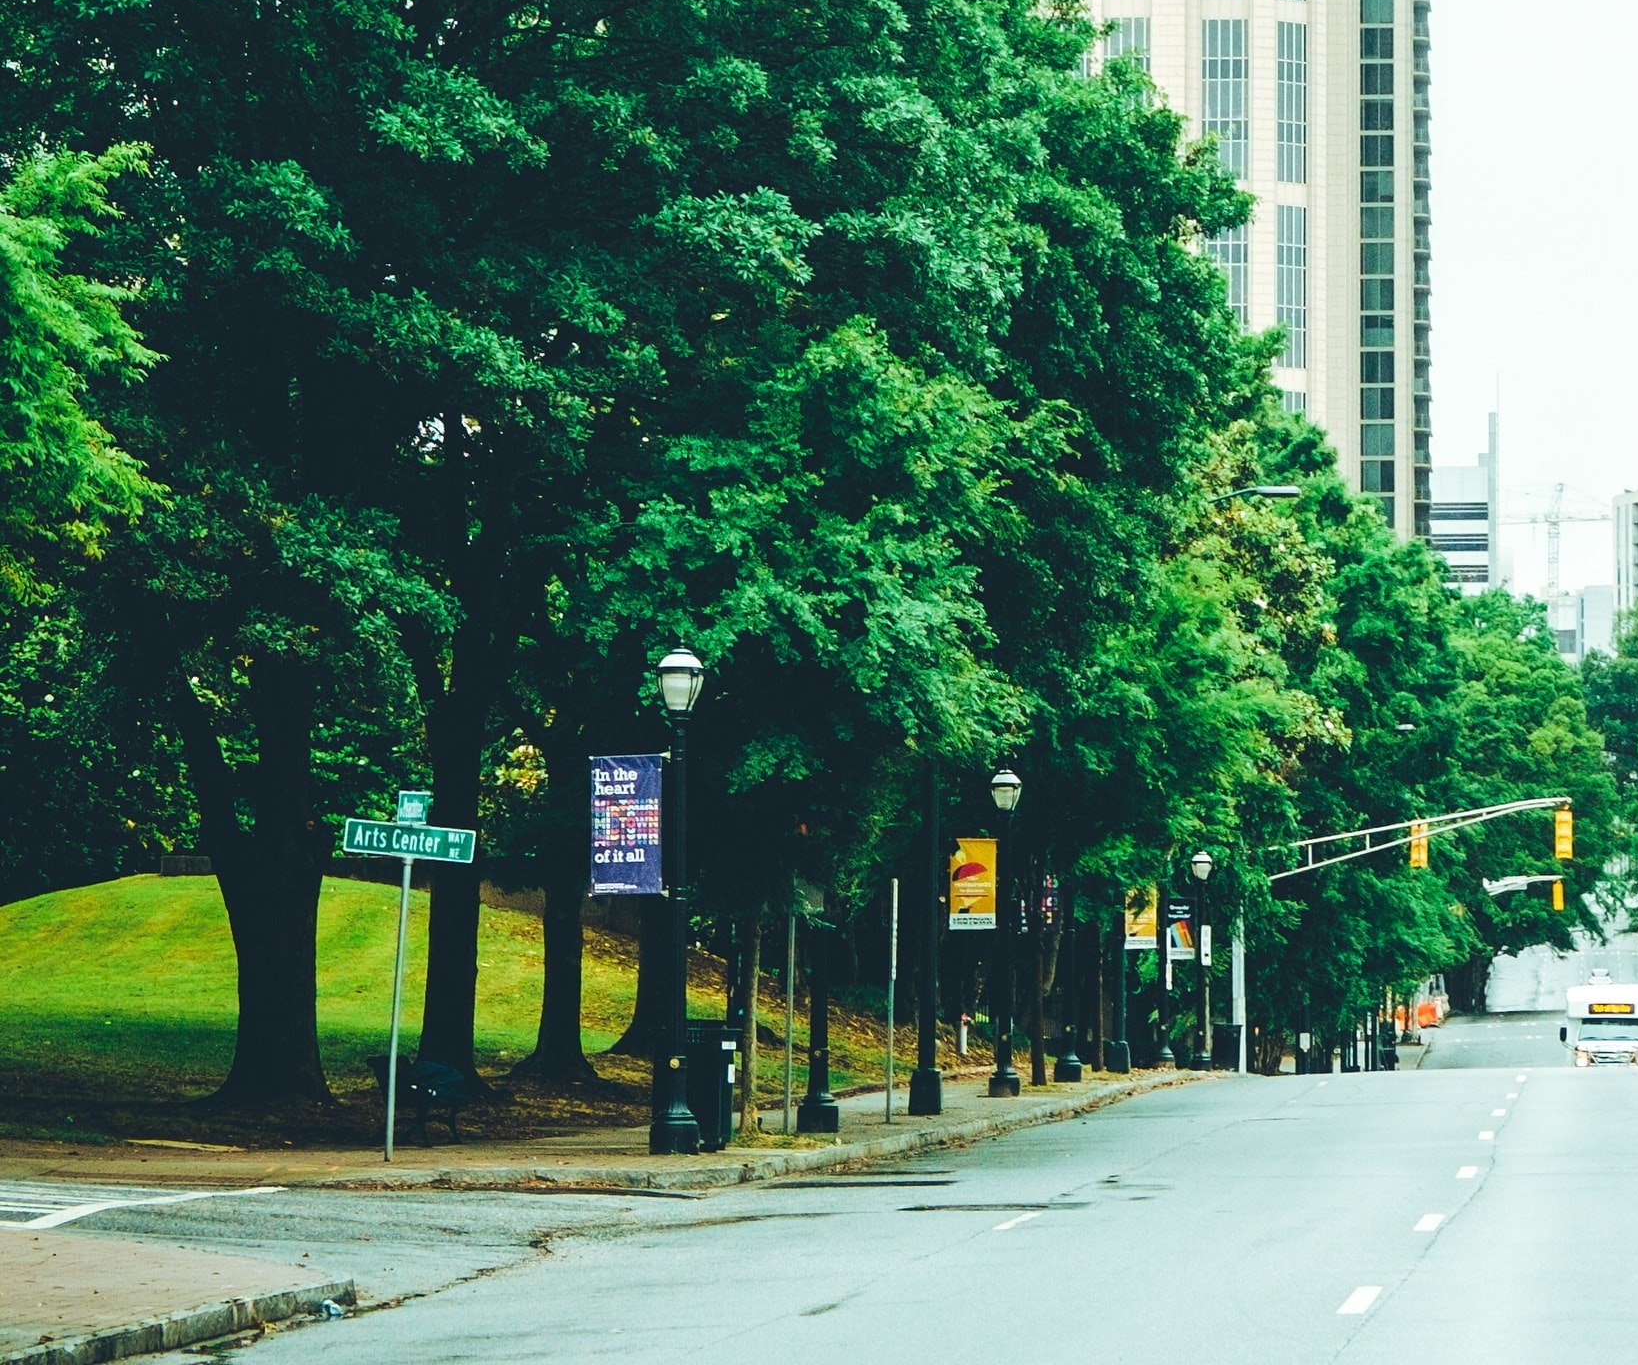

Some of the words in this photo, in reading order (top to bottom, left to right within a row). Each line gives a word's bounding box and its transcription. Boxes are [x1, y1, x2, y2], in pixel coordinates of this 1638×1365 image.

[594, 769, 610, 782] In
[613, 768, 638, 781] the
[594, 782, 636, 796] heart
[353, 825, 387, 848] Arts
[392, 829, 440, 853] Center
[448, 832, 466, 845] WAY
[594, 849, 611, 864] of
[612, 848, 624, 863] it
[626, 848, 645, 862] all
